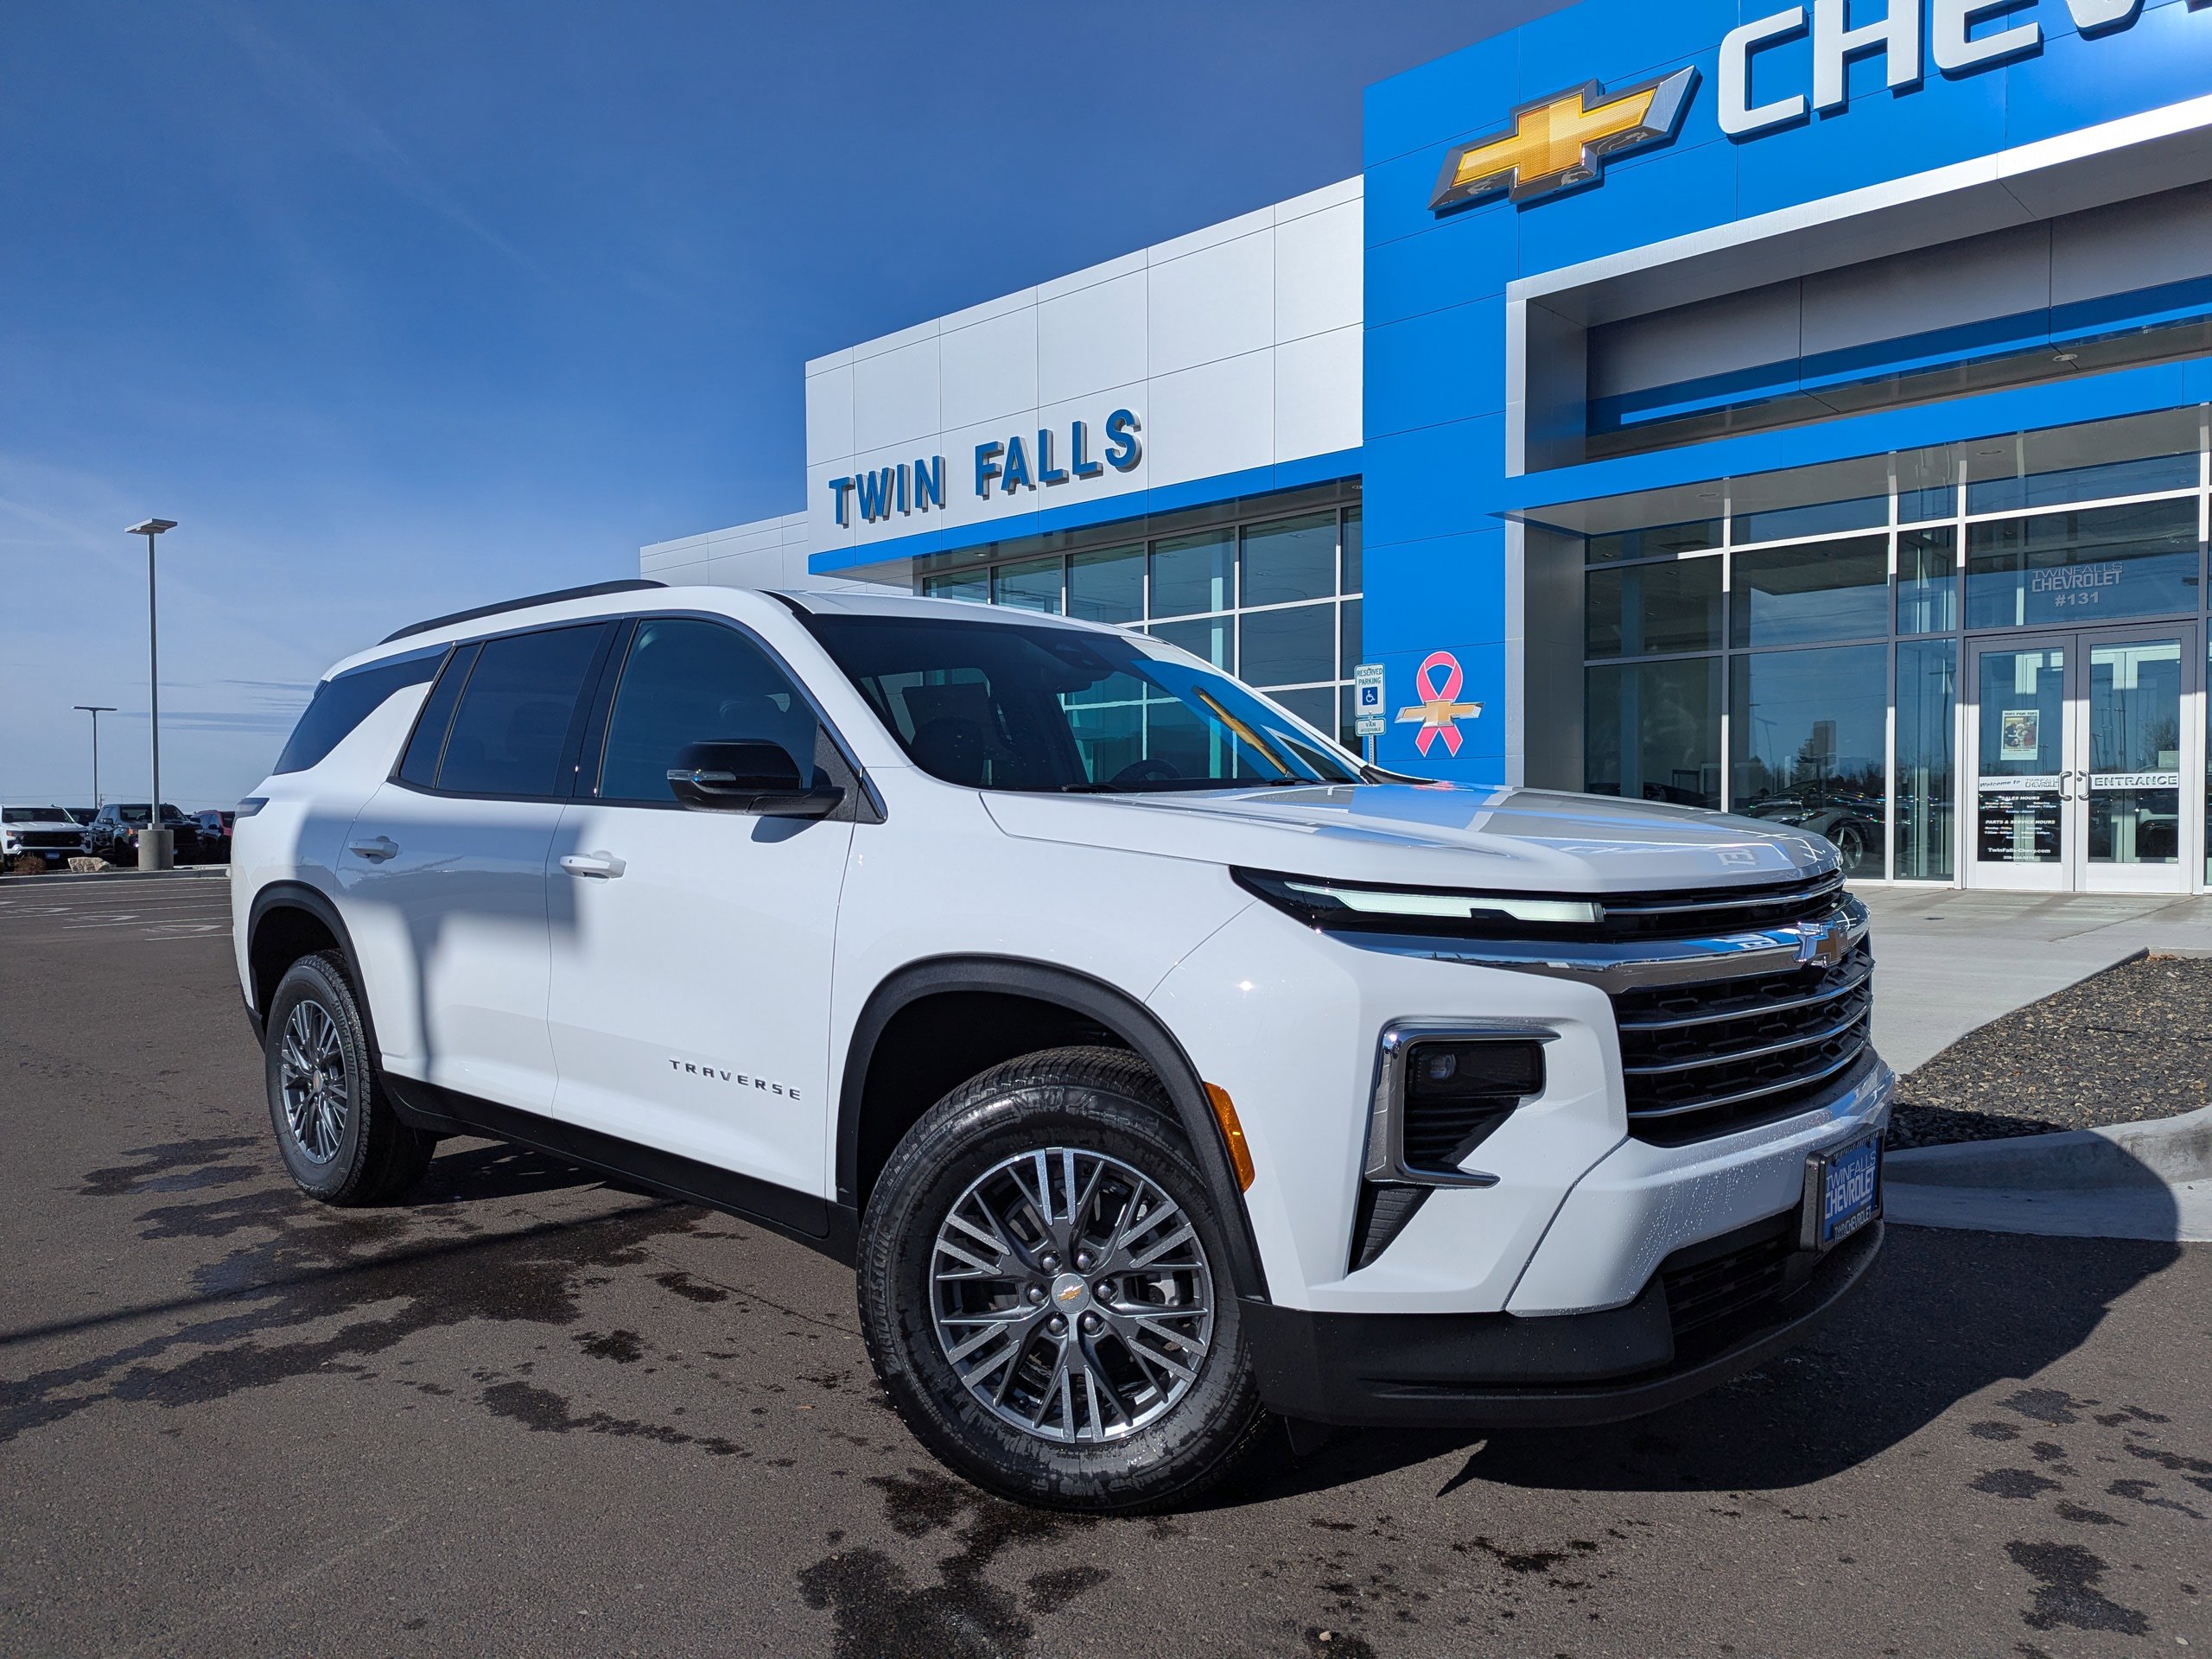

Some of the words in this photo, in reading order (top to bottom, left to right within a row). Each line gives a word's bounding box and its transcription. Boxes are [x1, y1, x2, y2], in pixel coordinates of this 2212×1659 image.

[829, 455, 946, 528] TWIN
[975, 408, 1143, 500] FALLS
[2032, 570, 2123, 593] CHEVROLET
[2055, 591, 2099, 607] #131
[1357, 667, 1383, 677] RESERVED
[1357, 677, 1382, 685] PARKING
[1980, 779, 2012, 788] Welcome
[2094, 775, 2177, 787] ENTRANCE
[669, 1059, 801, 1101] TRAVERSE
[1824, 1166, 1876, 1220] CHEVROLET
[1846, 1205, 1872, 1236] CHEVROLET
